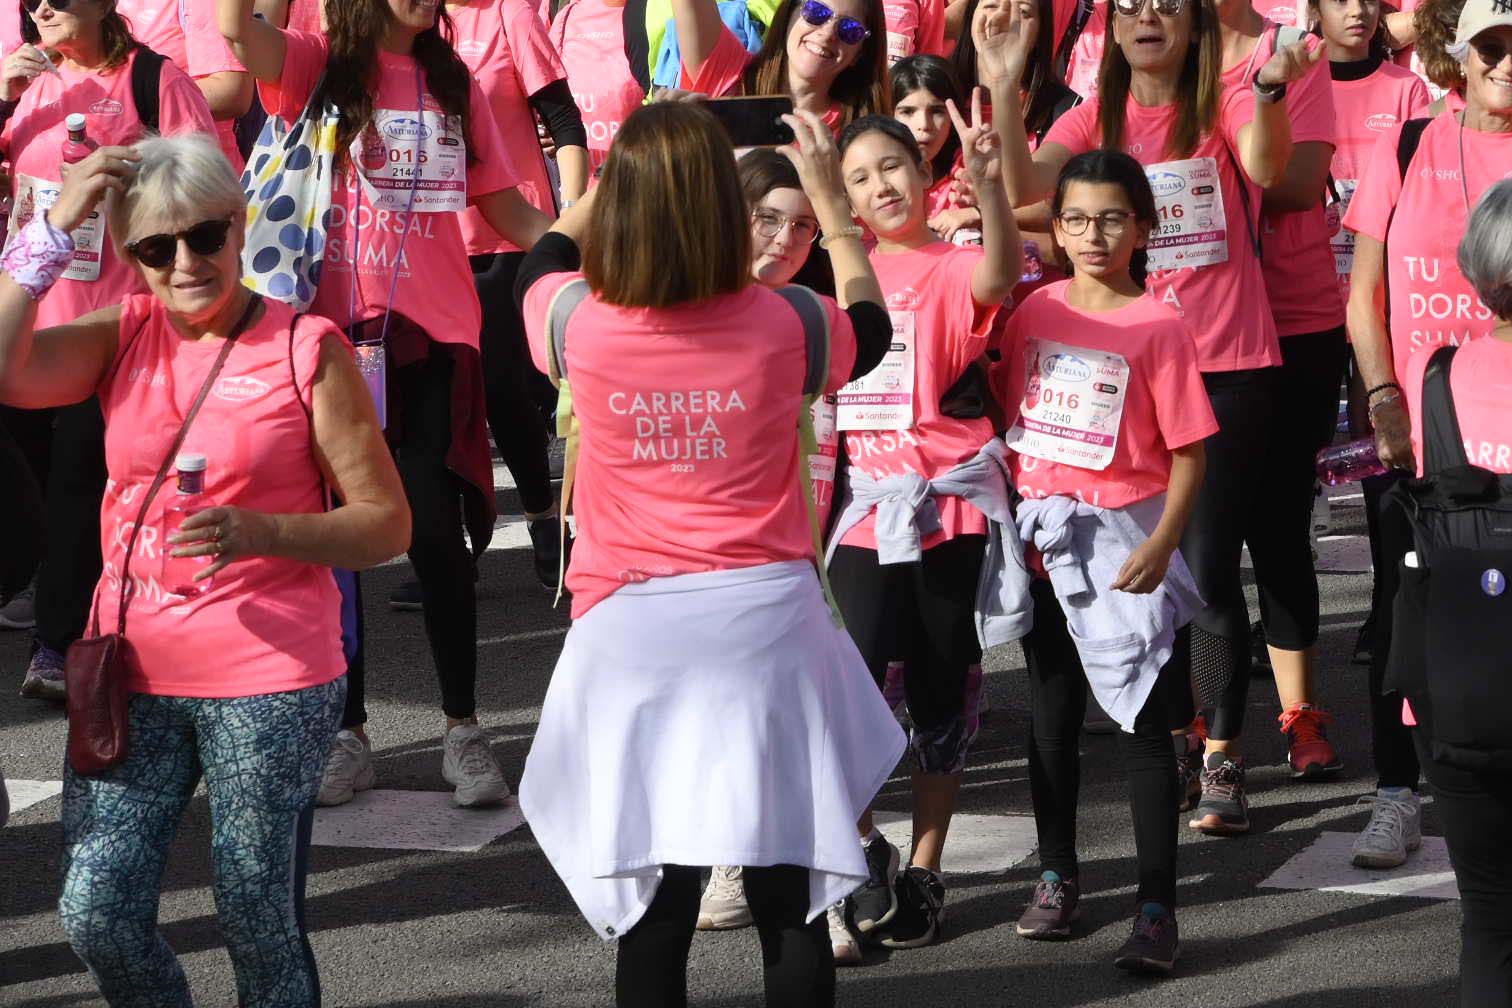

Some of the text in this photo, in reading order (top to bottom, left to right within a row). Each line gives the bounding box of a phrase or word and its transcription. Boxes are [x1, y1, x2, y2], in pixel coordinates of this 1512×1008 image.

[388, 148, 429, 164] 016
[1151, 181, 1182, 193] TURIANA
[423, 195, 460, 205] Santander
[1158, 204, 1184, 220] 16
[330, 203, 435, 239] DORSAL
[1175, 237, 1199, 245] MUJER
[327, 239, 409, 269] SUMA
[1184, 248, 1221, 259] Santander
[1403, 256, 1440, 282] TU
[1409, 293, 1492, 321] DORS
[1410, 329, 1472, 353] SUM
[843, 381, 865, 392] 1381
[608, 389, 747, 415] CARRERA
[859, 395, 882, 404] MUJER
[1043, 388, 1080, 410] 016
[1042, 409, 1072, 424] 21240
[635, 415, 721, 438] DE LA
[1042, 424, 1051, 434] DE
[1052, 426, 1061, 436] LA
[1062, 428, 1086, 441] MUJER
[632, 438, 728, 461] MUJER
[1066, 446, 1104, 461] Santander
[670, 463, 695, 473] 2023
